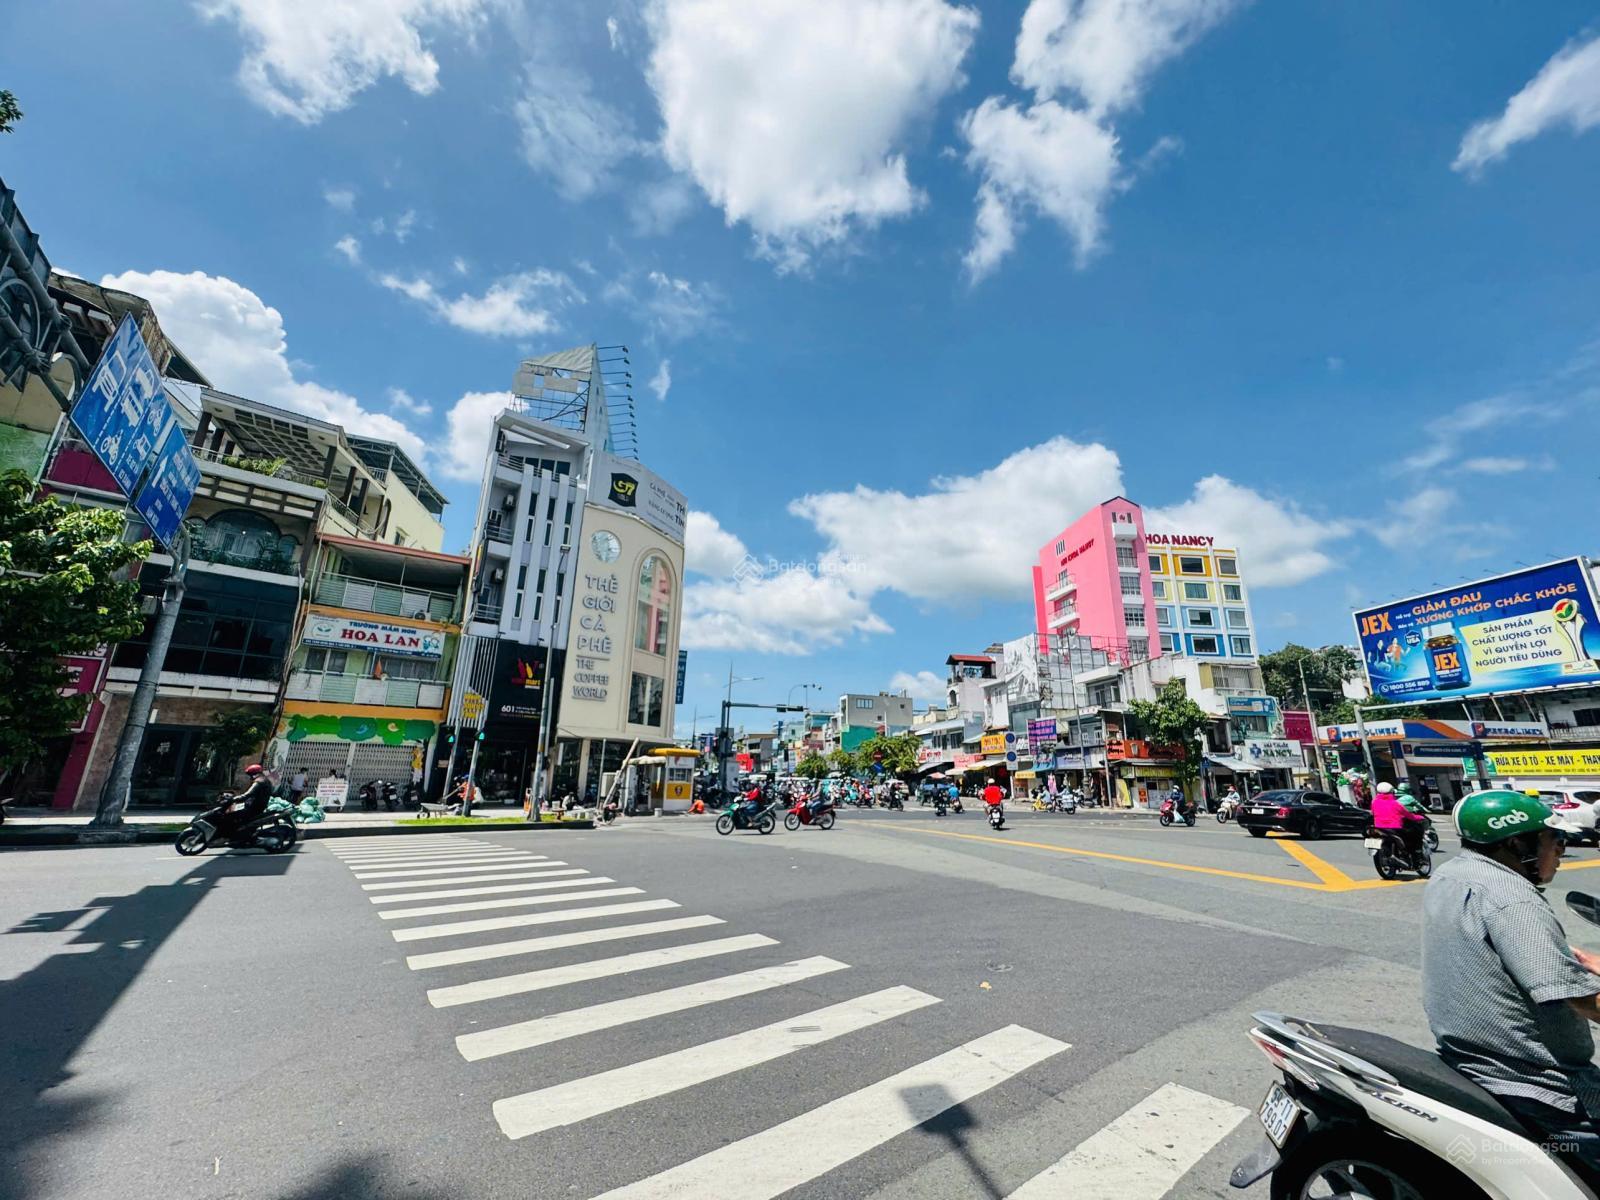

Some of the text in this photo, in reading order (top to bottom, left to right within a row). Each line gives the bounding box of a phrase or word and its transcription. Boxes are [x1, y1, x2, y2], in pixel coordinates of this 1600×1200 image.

[1171, 534, 1214, 546] NANCY
[1412, 600, 1447, 615] GIẢM
[1450, 592, 1482, 606] ĐAU
[1415, 610, 1454, 625] XƯƠNG
[1457, 602, 1492, 616] KHỚP
[1495, 592, 1533, 608] CHẮC
[1536, 583, 1577, 600] KHỎE
[1362, 612, 1393, 636] JEX
[341, 628, 420, 648] HOA LAN
[1407, 637, 1421, 645] USA
[1472, 623, 1553, 647] CHẤT LƯỢNG TỐT
[1434, 652, 1460, 671] JEX
[1508, 652, 1529, 663] TIÊU
[576, 659, 595, 670] THE
[574, 672, 609, 686] COFFEE
[572, 685, 608, 698] WORLD
[501, 705, 515, 713] 601
[1342, 727, 1398, 738] PETOLIMEX
[1485, 727, 1543, 736] PETROLIMEX
[1263, 749, 1292, 758] NANCY
[1496, 755, 1511, 767] RỬA
[1512, 756, 1521, 766] XE
[1545, 756, 1556, 766] XE
[1487, 809, 1529, 829] Grab
